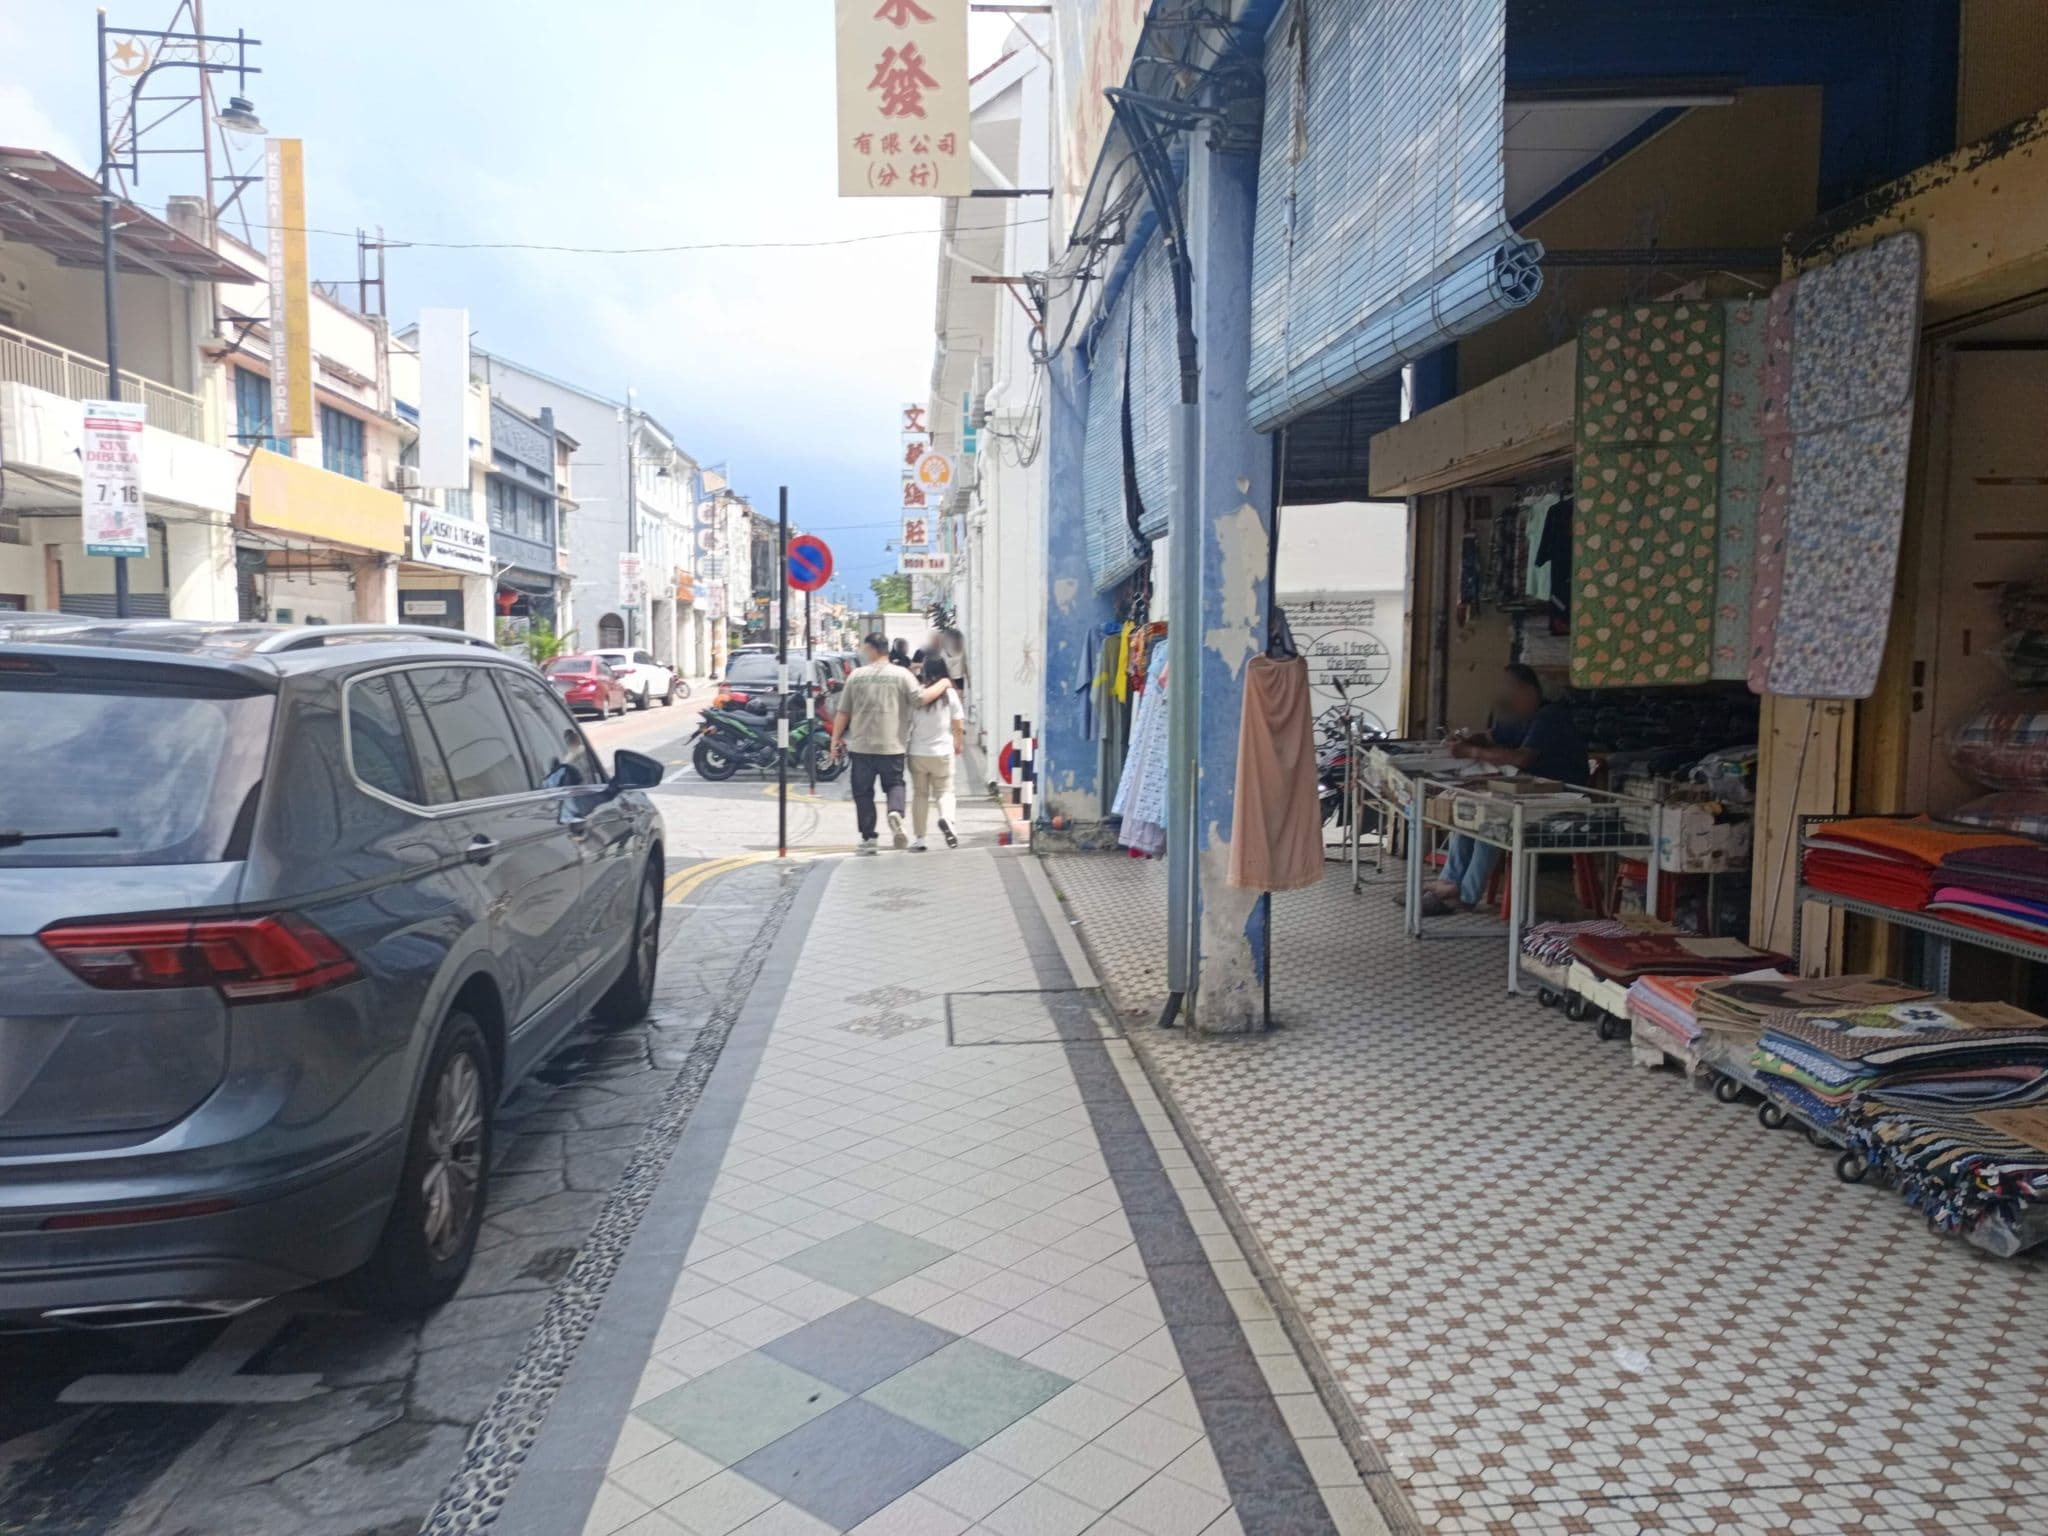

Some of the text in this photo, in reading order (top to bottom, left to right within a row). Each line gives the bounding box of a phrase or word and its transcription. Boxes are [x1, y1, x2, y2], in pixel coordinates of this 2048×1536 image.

[852, 132, 957, 156] 有限公司
[867, 161, 940, 189] (分行)
[267, 151, 281, 219] KEDAI
[274, 330, 288, 424] BELFORT
[97, 484, 139, 504] 7 16
